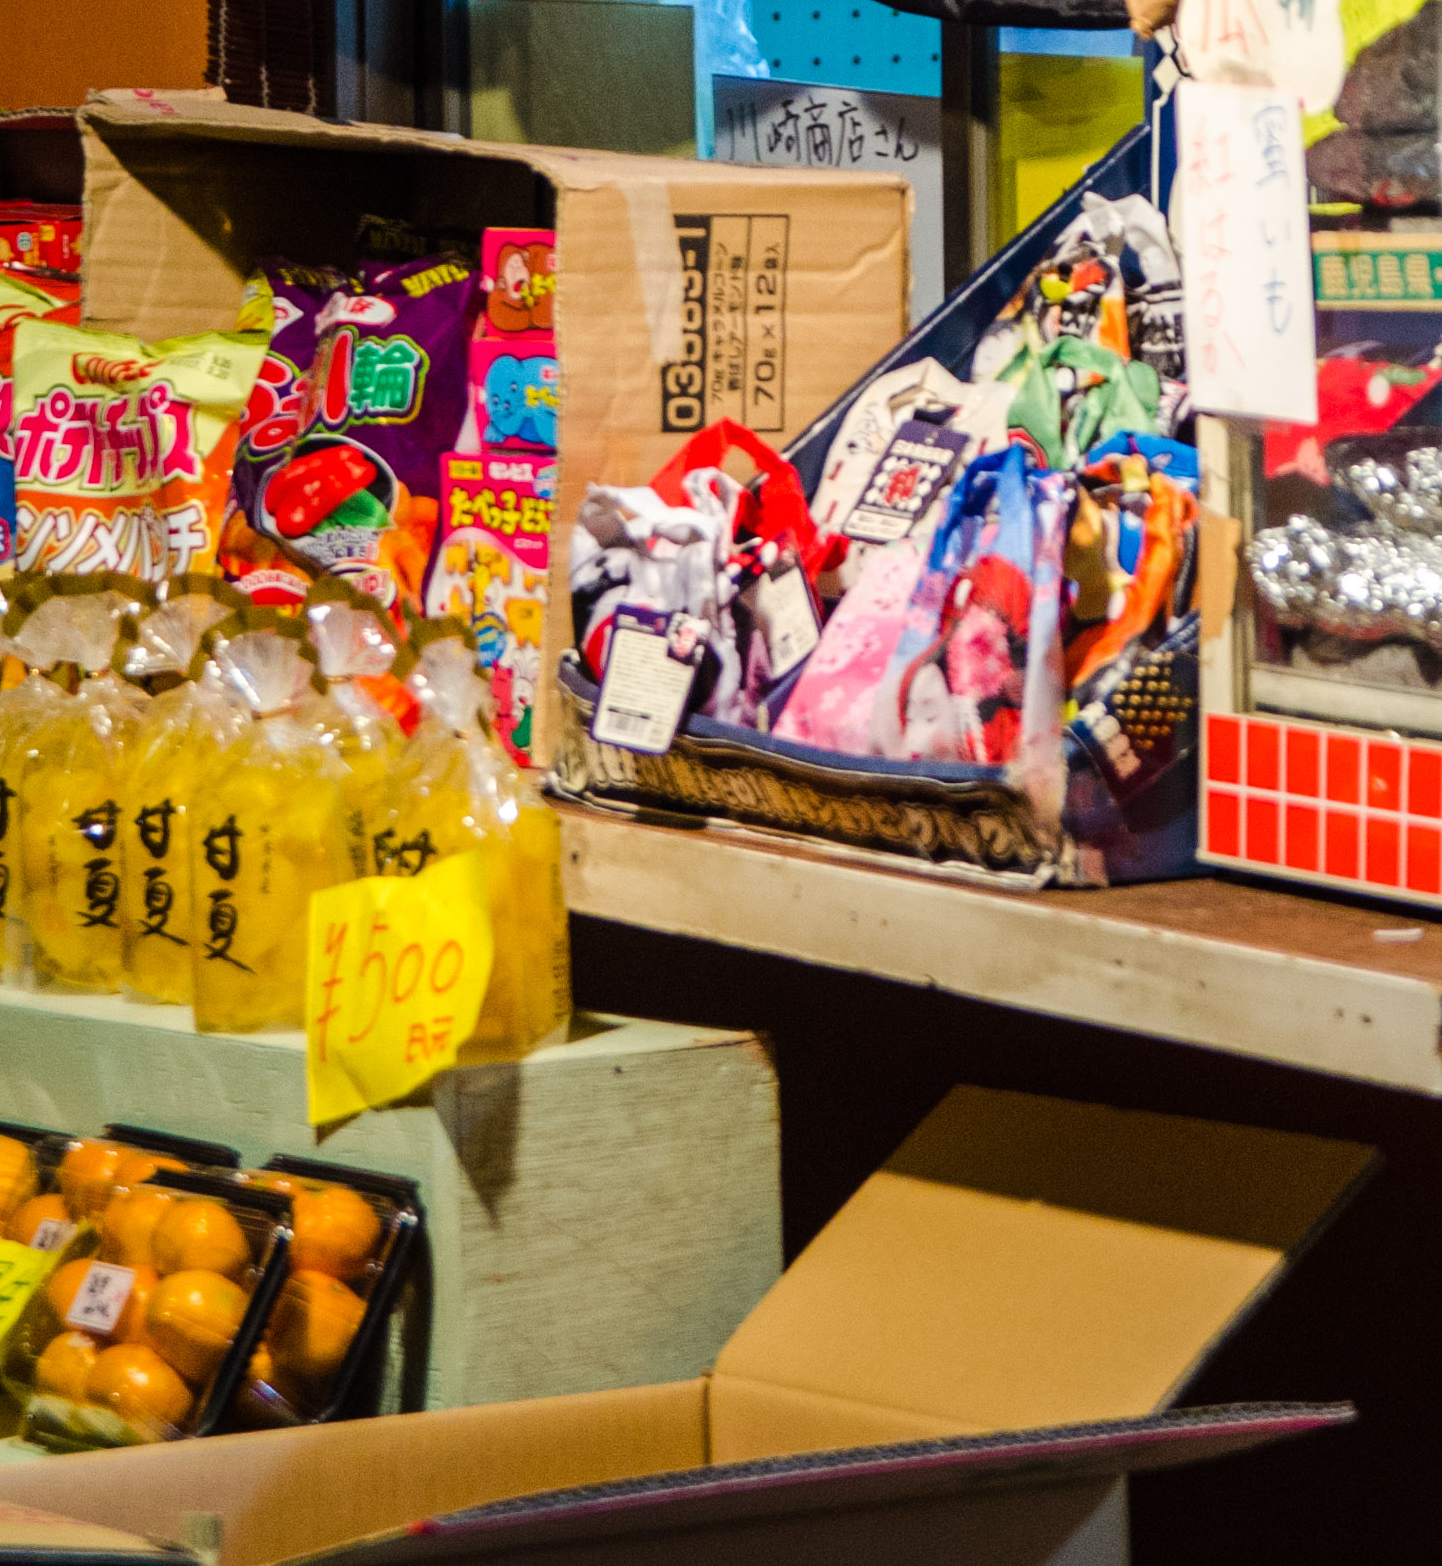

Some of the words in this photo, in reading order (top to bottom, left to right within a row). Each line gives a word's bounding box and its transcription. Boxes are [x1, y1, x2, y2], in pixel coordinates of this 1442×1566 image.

[71, 798, 123, 930] 甘夏
[134, 797, 191, 947] 甘夏
[202, 813, 256, 975] 甘夏
